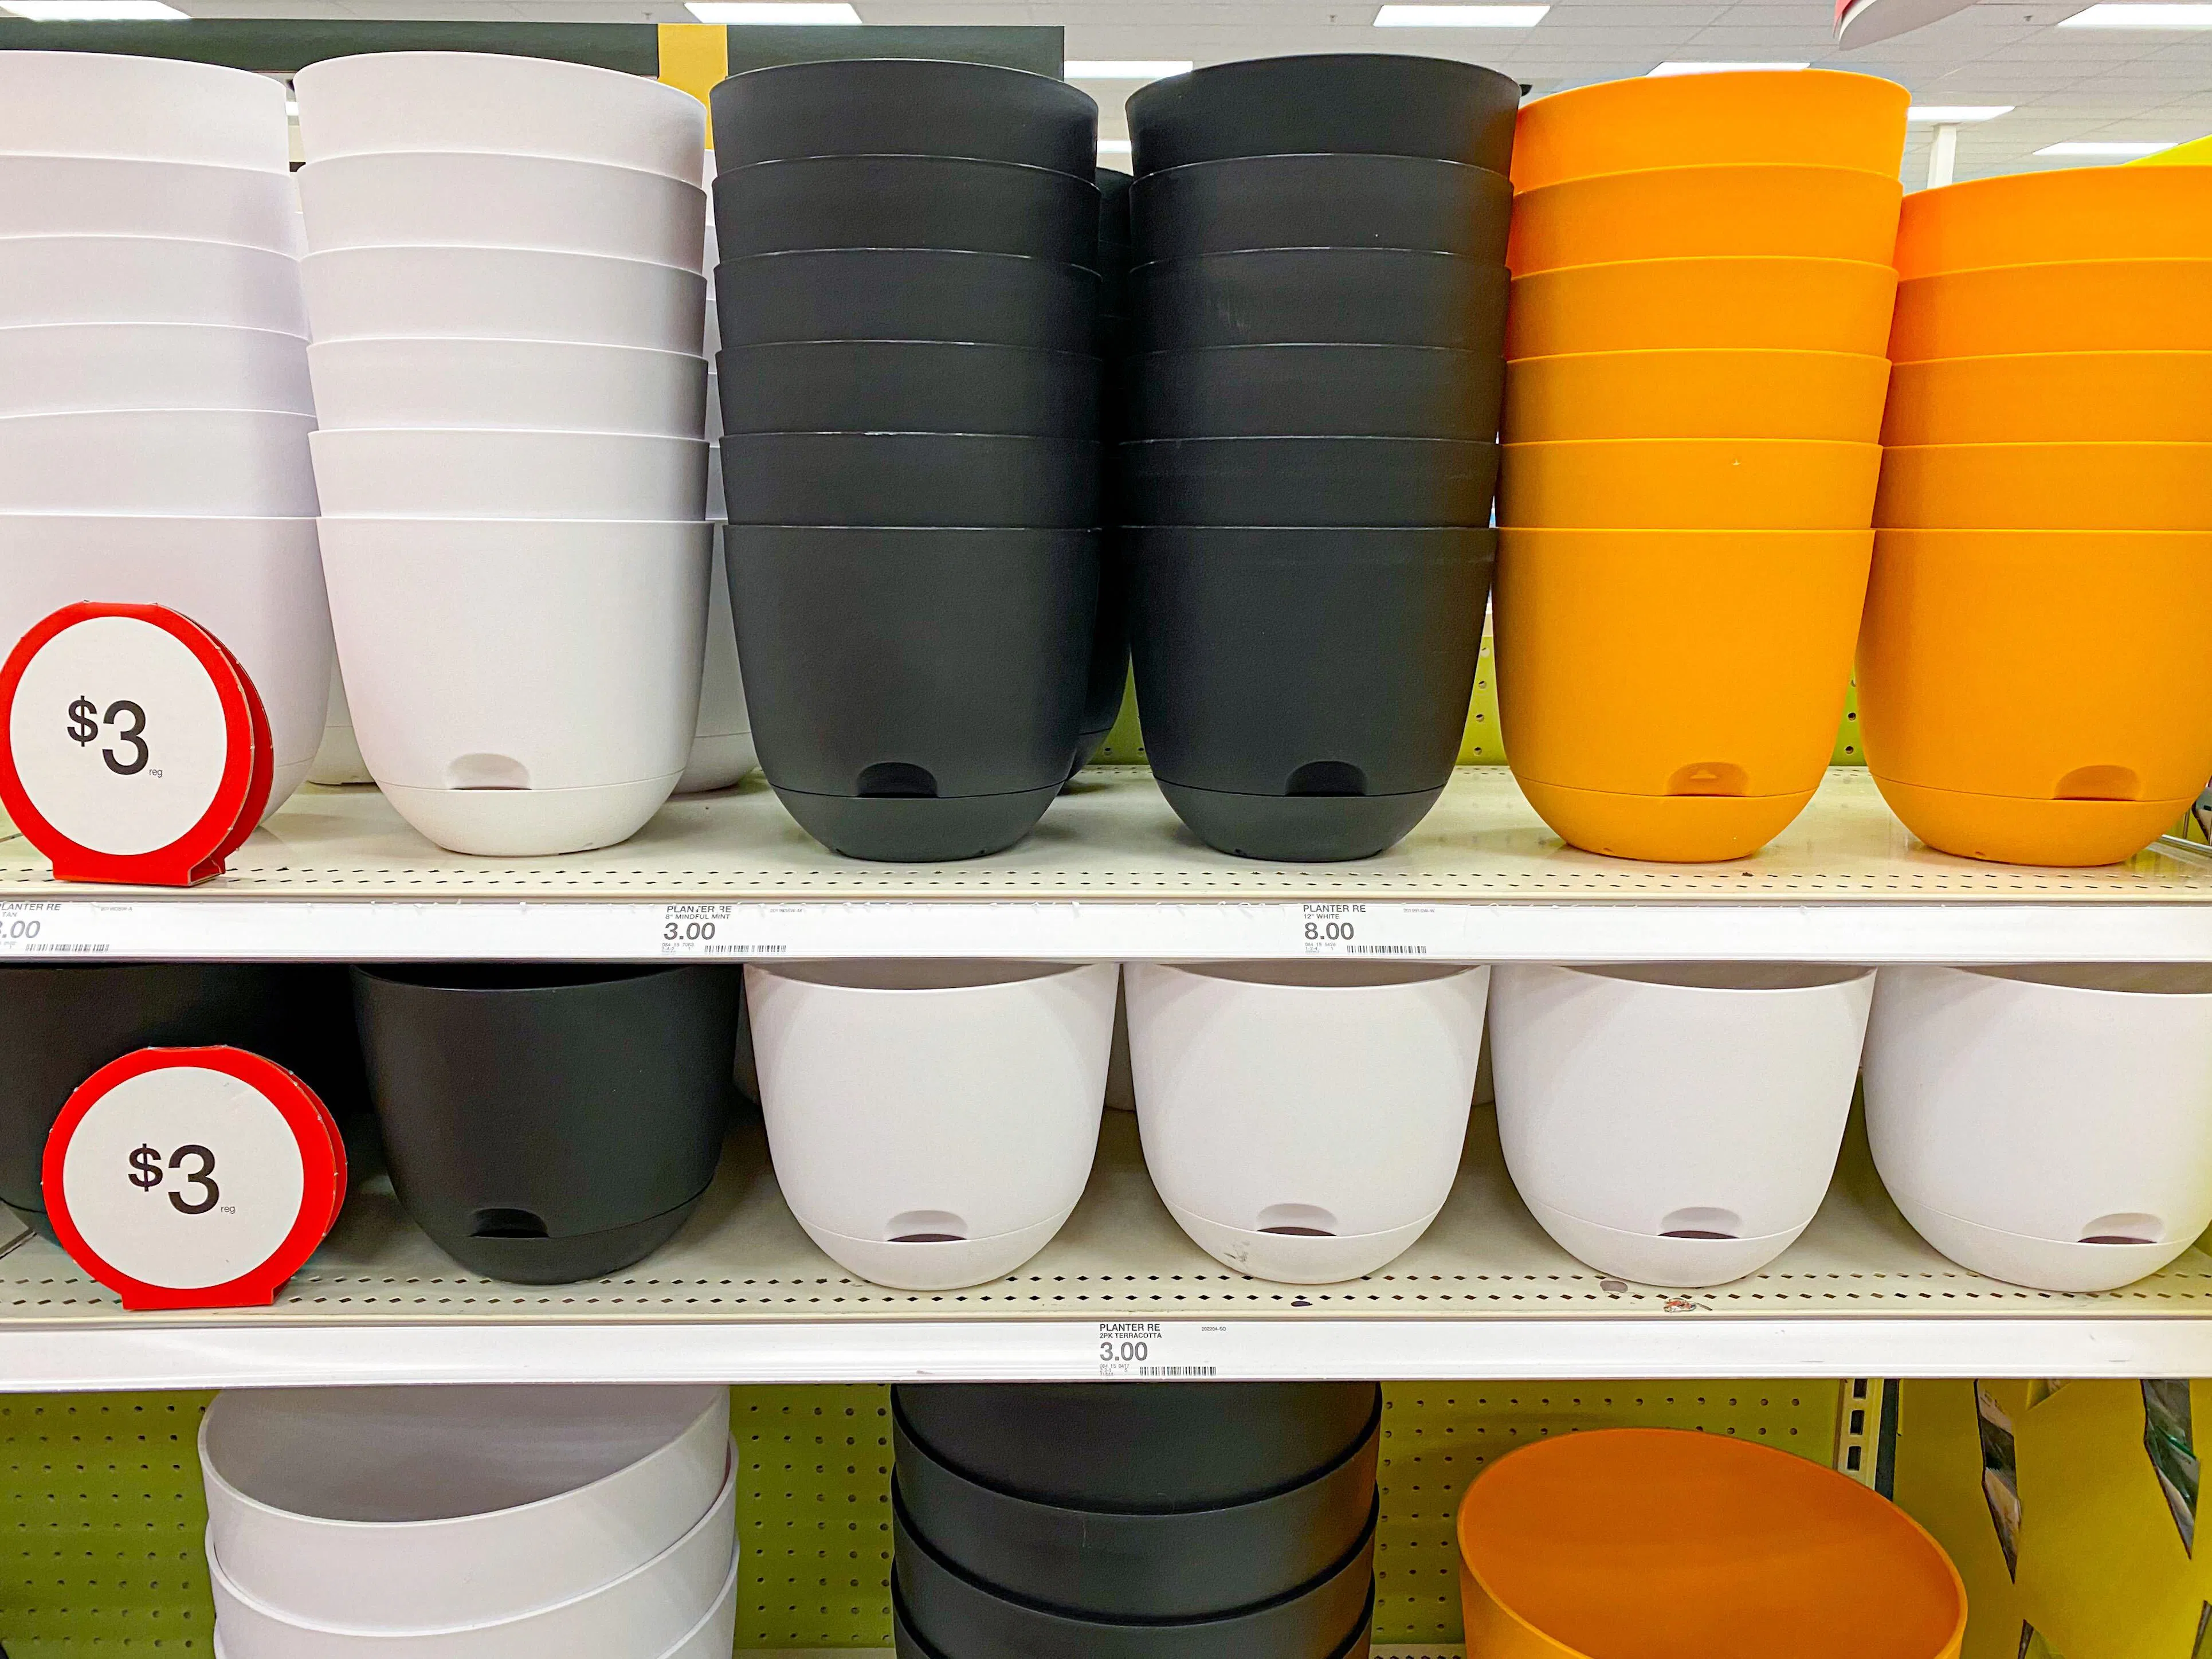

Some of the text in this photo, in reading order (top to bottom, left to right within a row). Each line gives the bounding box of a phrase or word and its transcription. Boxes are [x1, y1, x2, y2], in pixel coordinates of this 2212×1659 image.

[148, 768, 163, 778] reg
[0, 920, 41, 939] .00
[664, 922, 716, 940] 3.00
[1304, 922, 1354, 940] 8.00
[220, 1206, 235, 1214] reg
[1099, 1323, 1160, 1331] PLANTER RE
[1100, 1342, 1148, 1361] 3.00
